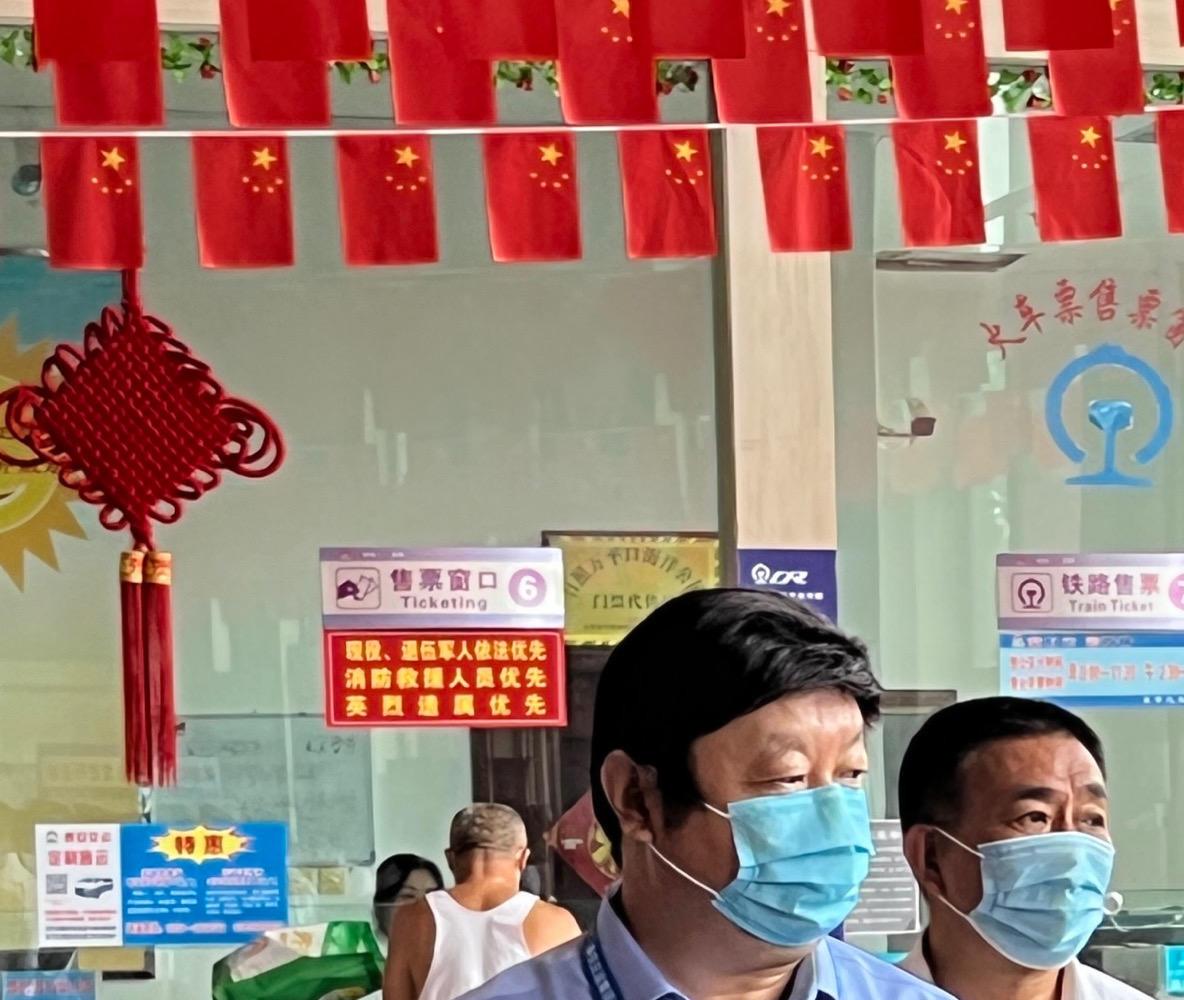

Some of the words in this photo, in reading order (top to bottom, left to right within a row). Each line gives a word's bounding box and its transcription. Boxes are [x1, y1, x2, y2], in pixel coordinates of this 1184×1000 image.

[390, 567, 498, 592] 售票窗口
[517, 574, 539, 601] 6
[1061, 572, 1160, 596] 铁路售票
[400, 595, 488, 611] Ticketing
[1068, 599, 1107, 613] Train
[1111, 598, 1154, 612] Ticket
[344, 666, 548, 690] 消防救援人员优先
